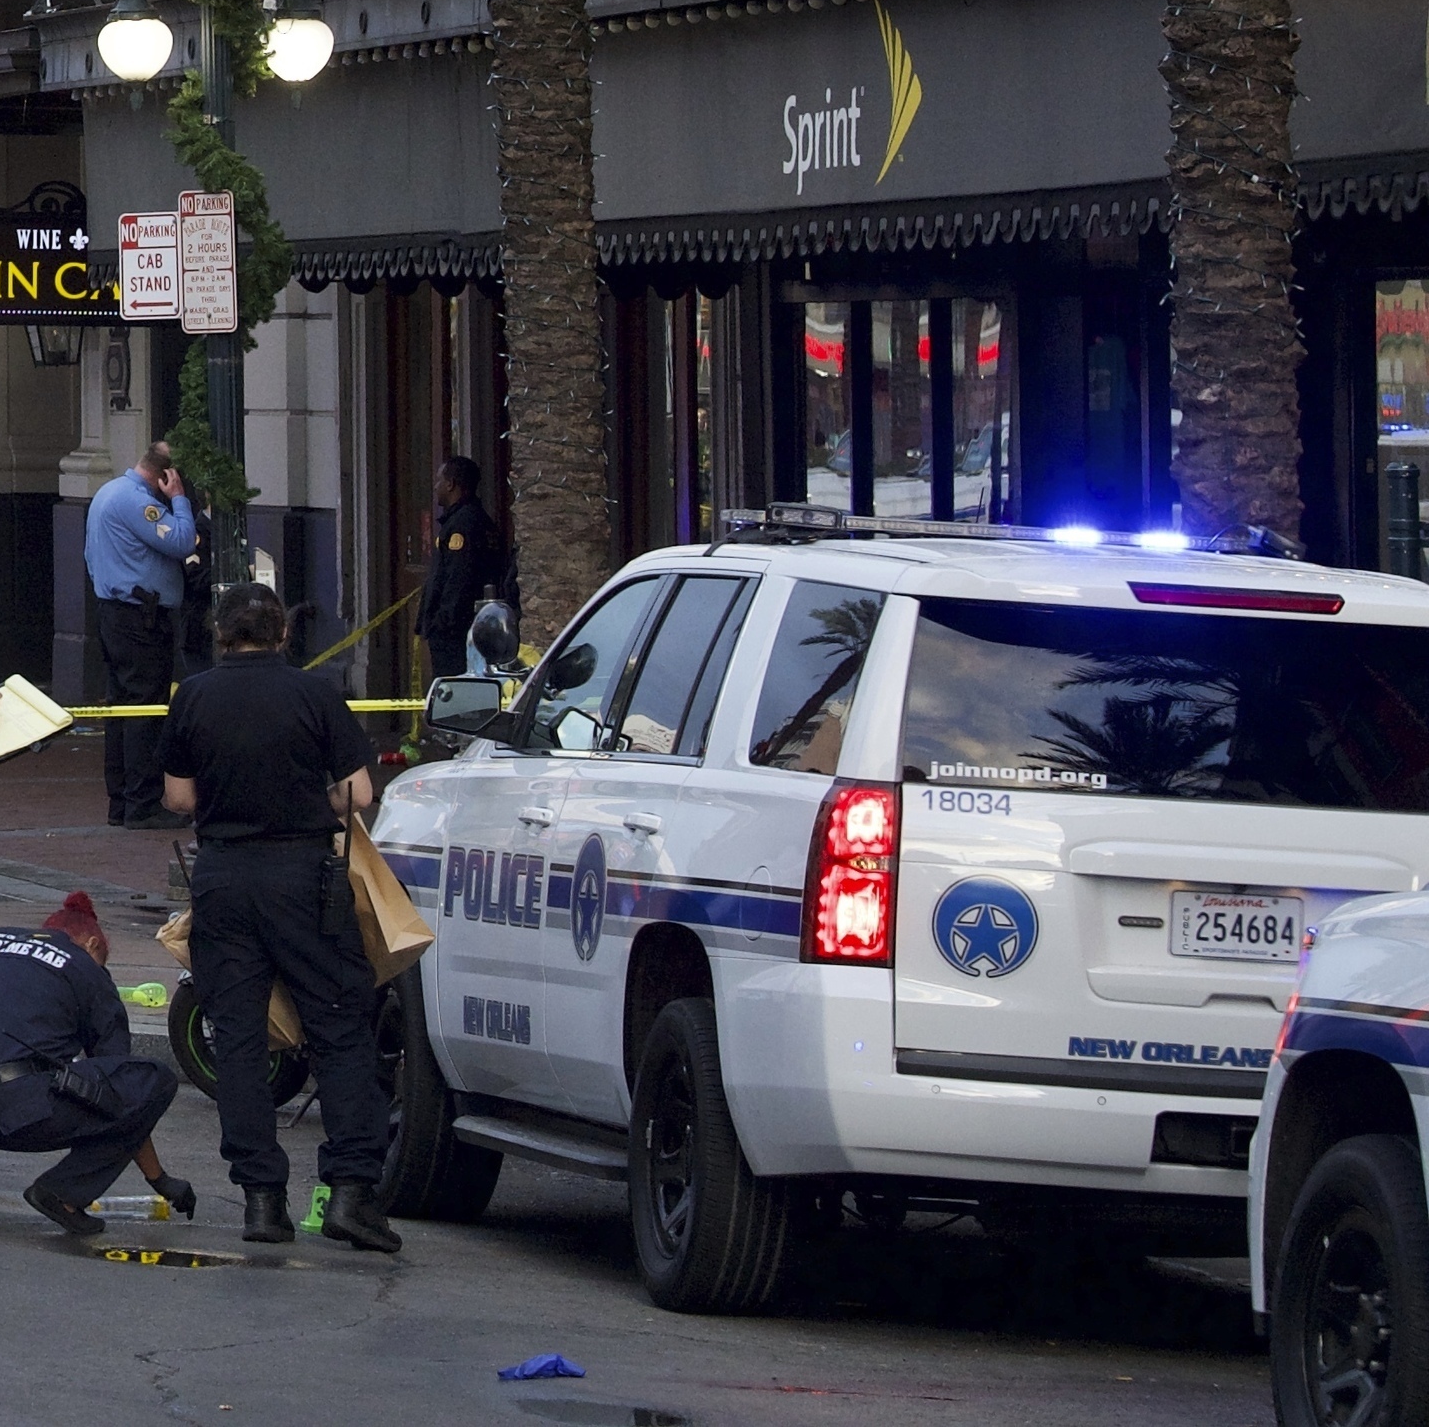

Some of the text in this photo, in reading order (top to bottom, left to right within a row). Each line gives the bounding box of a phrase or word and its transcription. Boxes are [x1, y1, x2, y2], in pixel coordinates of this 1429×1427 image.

[783, 86, 861, 195] Sprint
[181, 196, 229, 213] NO PARKING
[16, 229, 62, 250] WINE
[121, 223, 175, 242] NO PARKING
[187, 243, 227, 253] 2 HOURS
[137, 253, 163, 269] CAB
[130, 276, 171, 292] STAND
[926, 761, 1107, 789] joinnopd.org
[921, 790, 1012, 816] 18034
[444, 846, 544, 930] POLICE
[1202, 895, 1269, 909] Louisiana
[1196, 912, 1295, 945] 254684
[31, 946, 67, 969] LAB
[463, 995, 531, 1045] NEW ORLEANS
[1068, 1036, 1275, 1069] NEW ORLEANS
